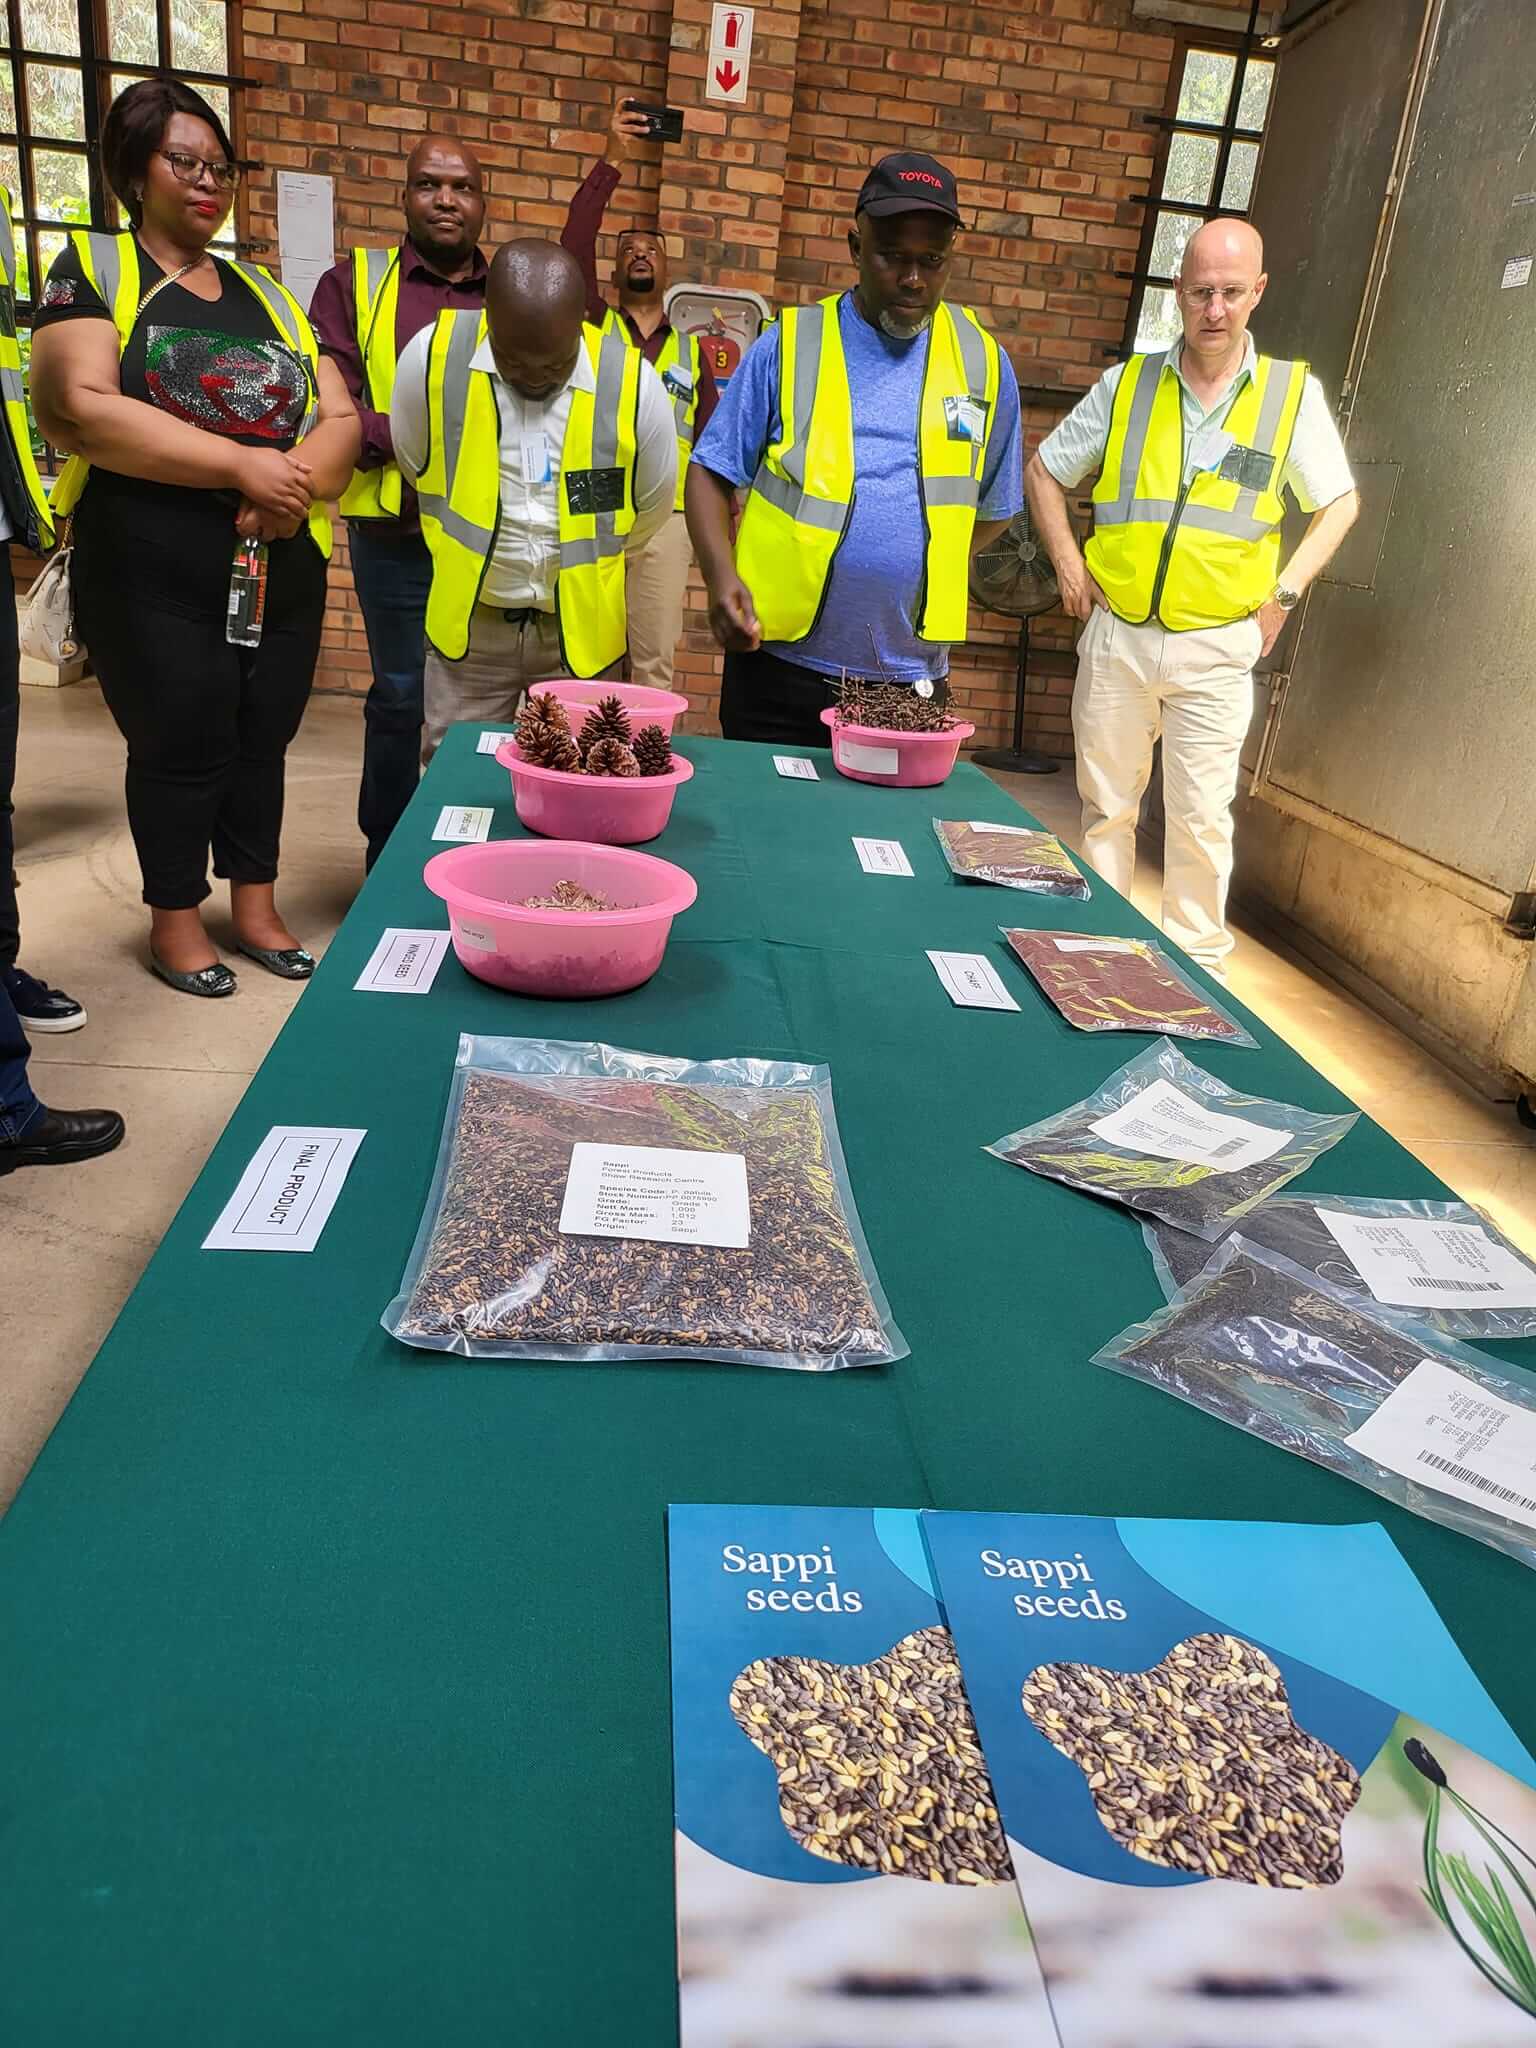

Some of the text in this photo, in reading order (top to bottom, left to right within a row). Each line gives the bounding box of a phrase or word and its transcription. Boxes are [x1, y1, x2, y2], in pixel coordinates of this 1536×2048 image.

[898, 169, 943, 188] TOYOTA
[717, 351, 727, 368] 3
[395, 964, 411, 978] SEED
[964, 970, 982, 989] CHAFF
[633, 1169, 672, 1177] Products
[266, 1144, 320, 1225] FINAL PRODUCT
[600, 1185, 637, 1193] Species
[594, 1222, 627, 1230] Origin:
[722, 1544, 838, 1582] Sappi
[979, 1550, 1094, 1589] Sappi
[745, 1582, 863, 1613] seeds
[1013, 1588, 1128, 1621] seeds
